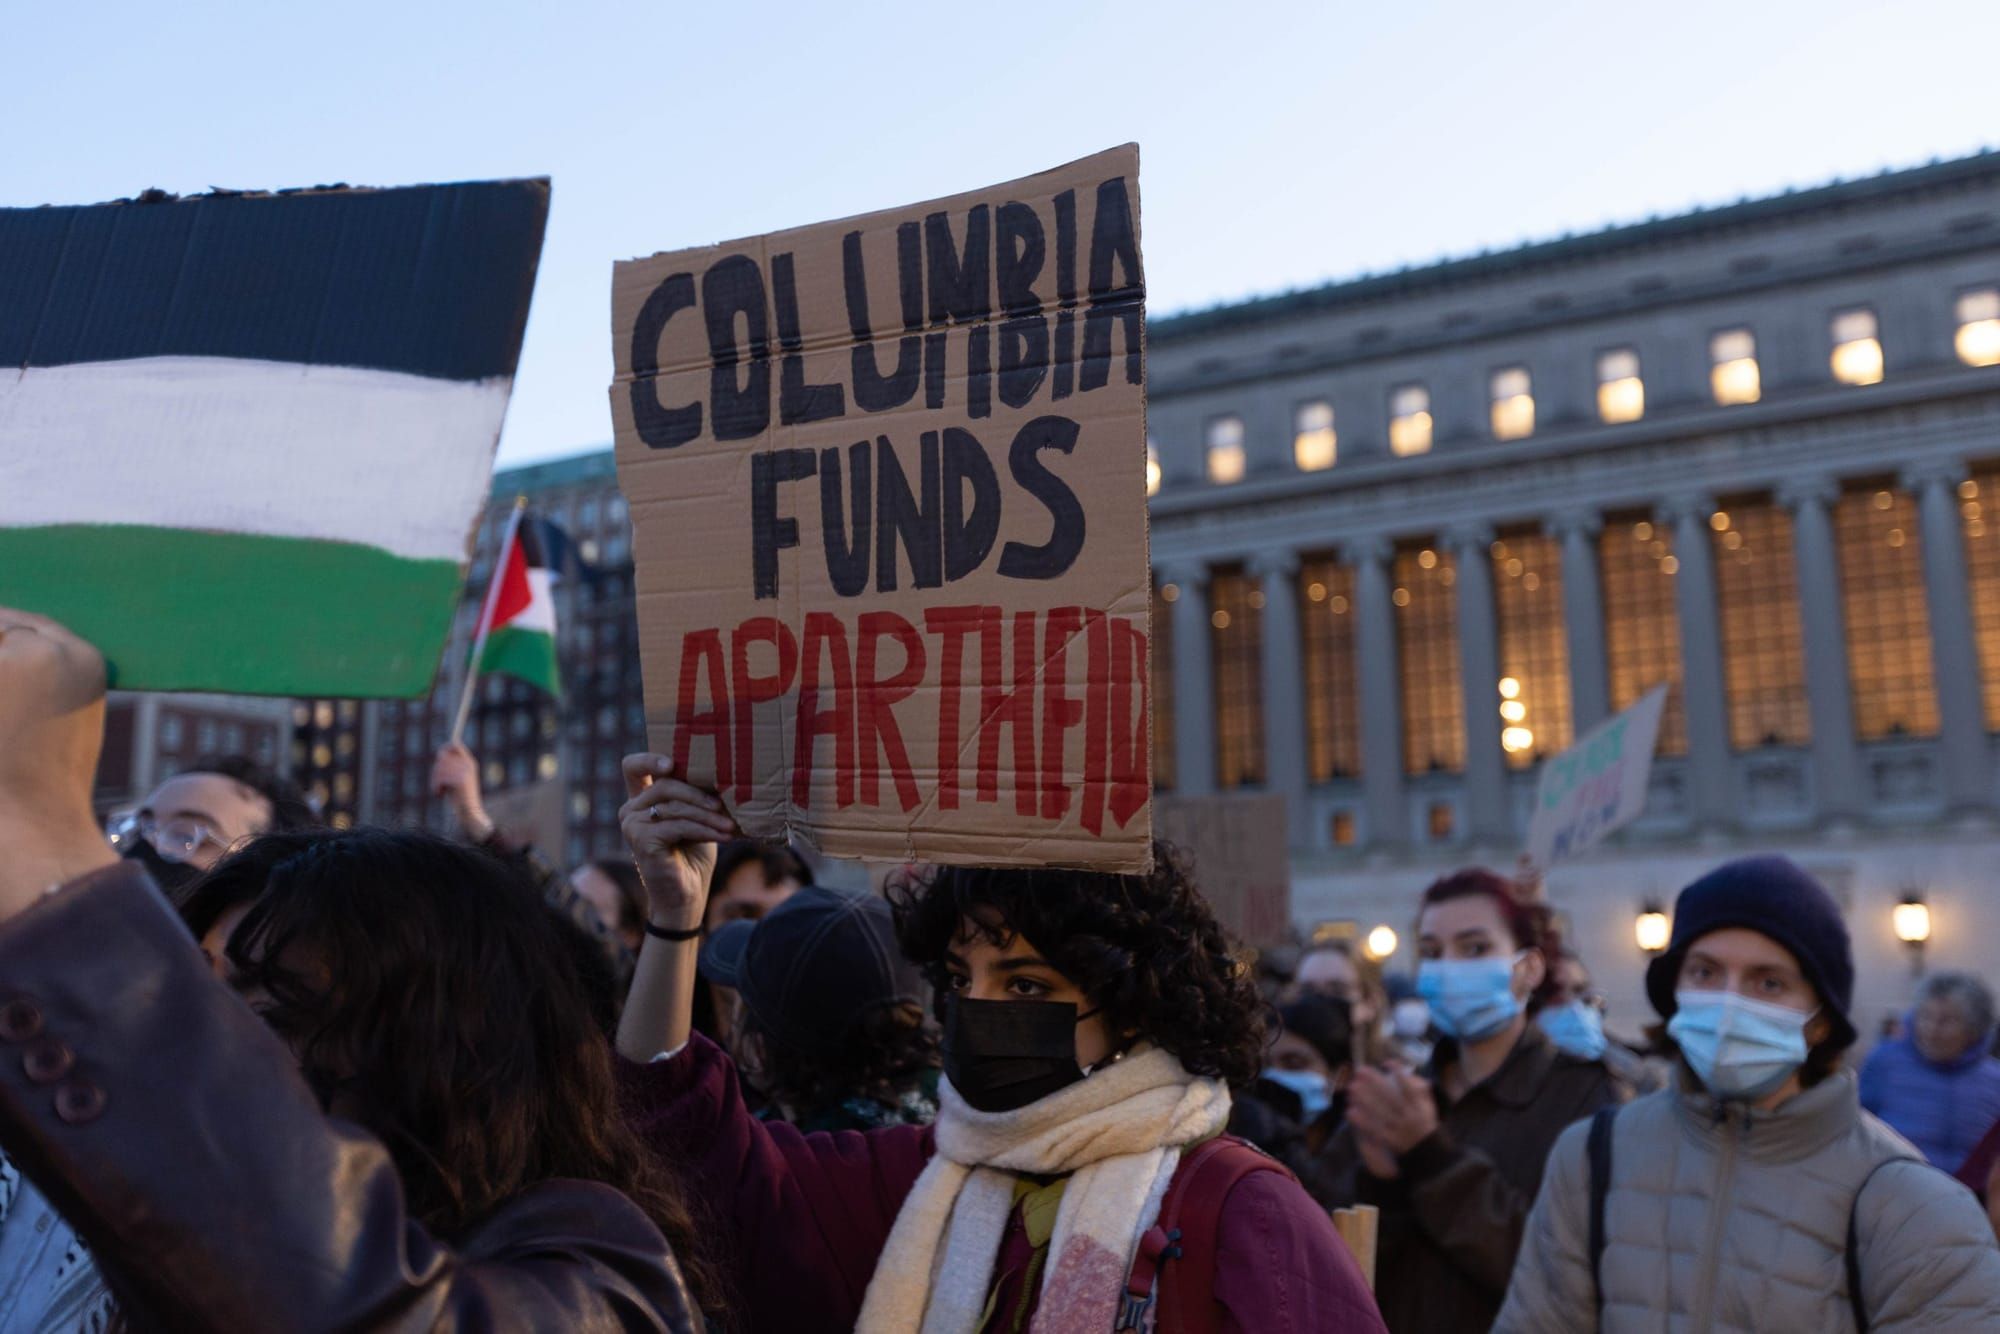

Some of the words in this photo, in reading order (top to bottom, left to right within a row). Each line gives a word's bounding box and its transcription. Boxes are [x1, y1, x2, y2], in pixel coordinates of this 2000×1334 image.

[631, 176, 1143, 450] COLUMBIA
[751, 415, 1087, 600] FUNDS
[672, 605, 1149, 837] APARTHEID
